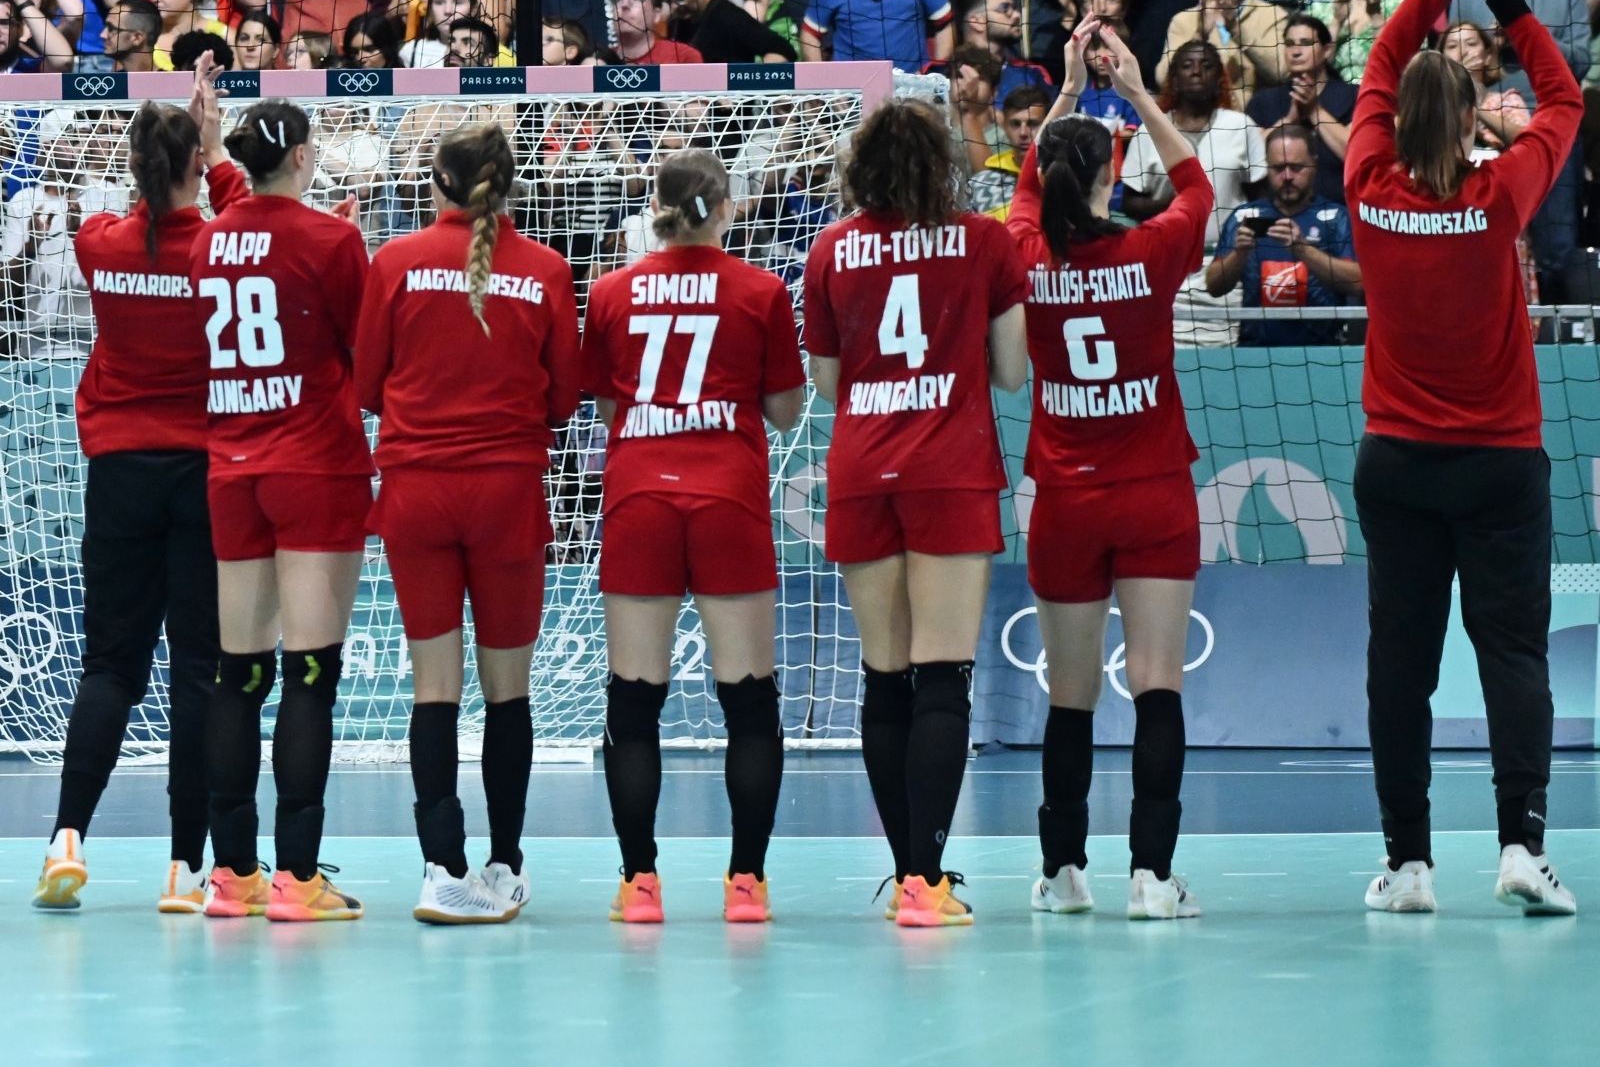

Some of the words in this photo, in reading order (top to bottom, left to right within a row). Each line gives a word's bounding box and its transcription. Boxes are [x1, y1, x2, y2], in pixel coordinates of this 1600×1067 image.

[230, 80, 258, 88] 2024
[461, 77, 492, 85] PARIS
[495, 76, 524, 85] 2024
[729, 72, 761, 81] PARIS
[764, 71, 793, 80] 2024
[1358, 201, 1488, 235] MAGYARORSZÁG
[208, 231, 272, 266] PAPP
[406, 268, 544, 305] MAGYARSZÁG
[631, 272, 719, 306] SIMON
[198, 276, 285, 369] 28
[877, 273, 929, 369] 4
[628, 314, 721, 406] 77
[846, 372, 956, 416] HUNGARY
[1041, 375, 1160, 418] HUNGARY
[619, 400, 738, 439] HUNGARY
